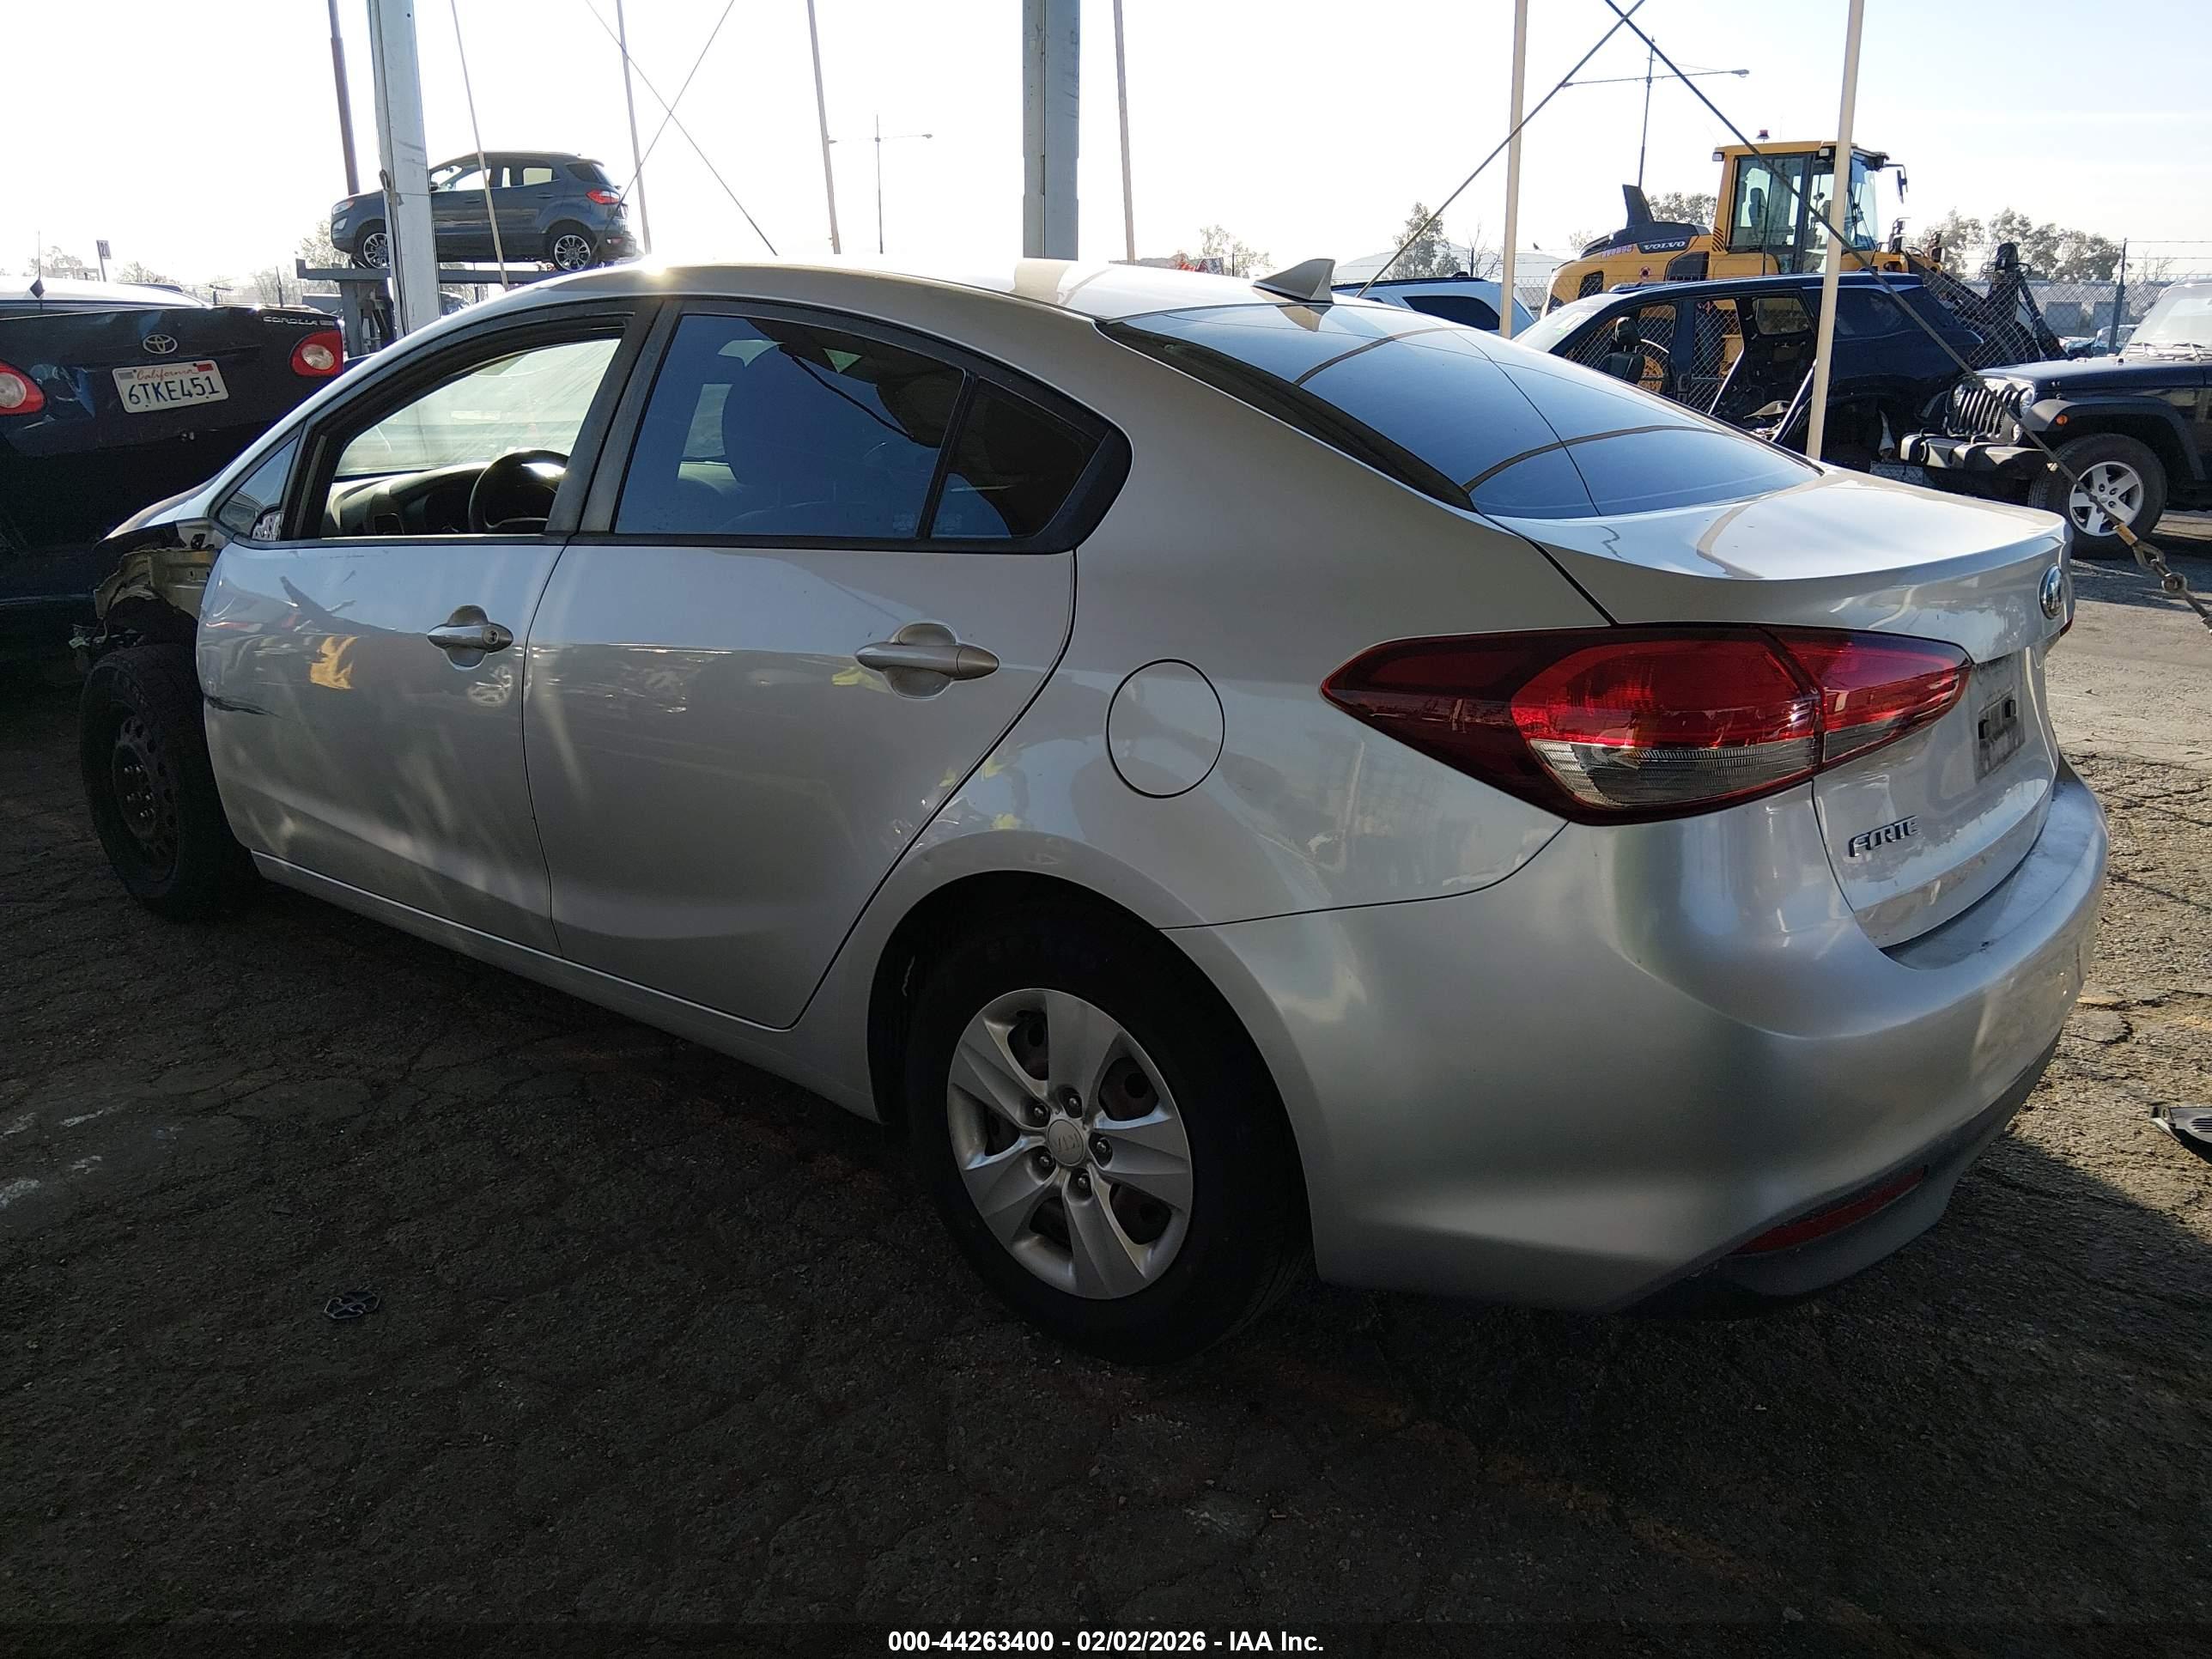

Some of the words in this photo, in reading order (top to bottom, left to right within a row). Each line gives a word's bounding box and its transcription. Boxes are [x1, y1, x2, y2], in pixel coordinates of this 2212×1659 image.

[1644, 240, 1686, 251] VOLVO
[263, 316, 318, 325] COROLLA
[137, 368, 196, 381] California
[129, 375, 220, 405] 6TKE451
